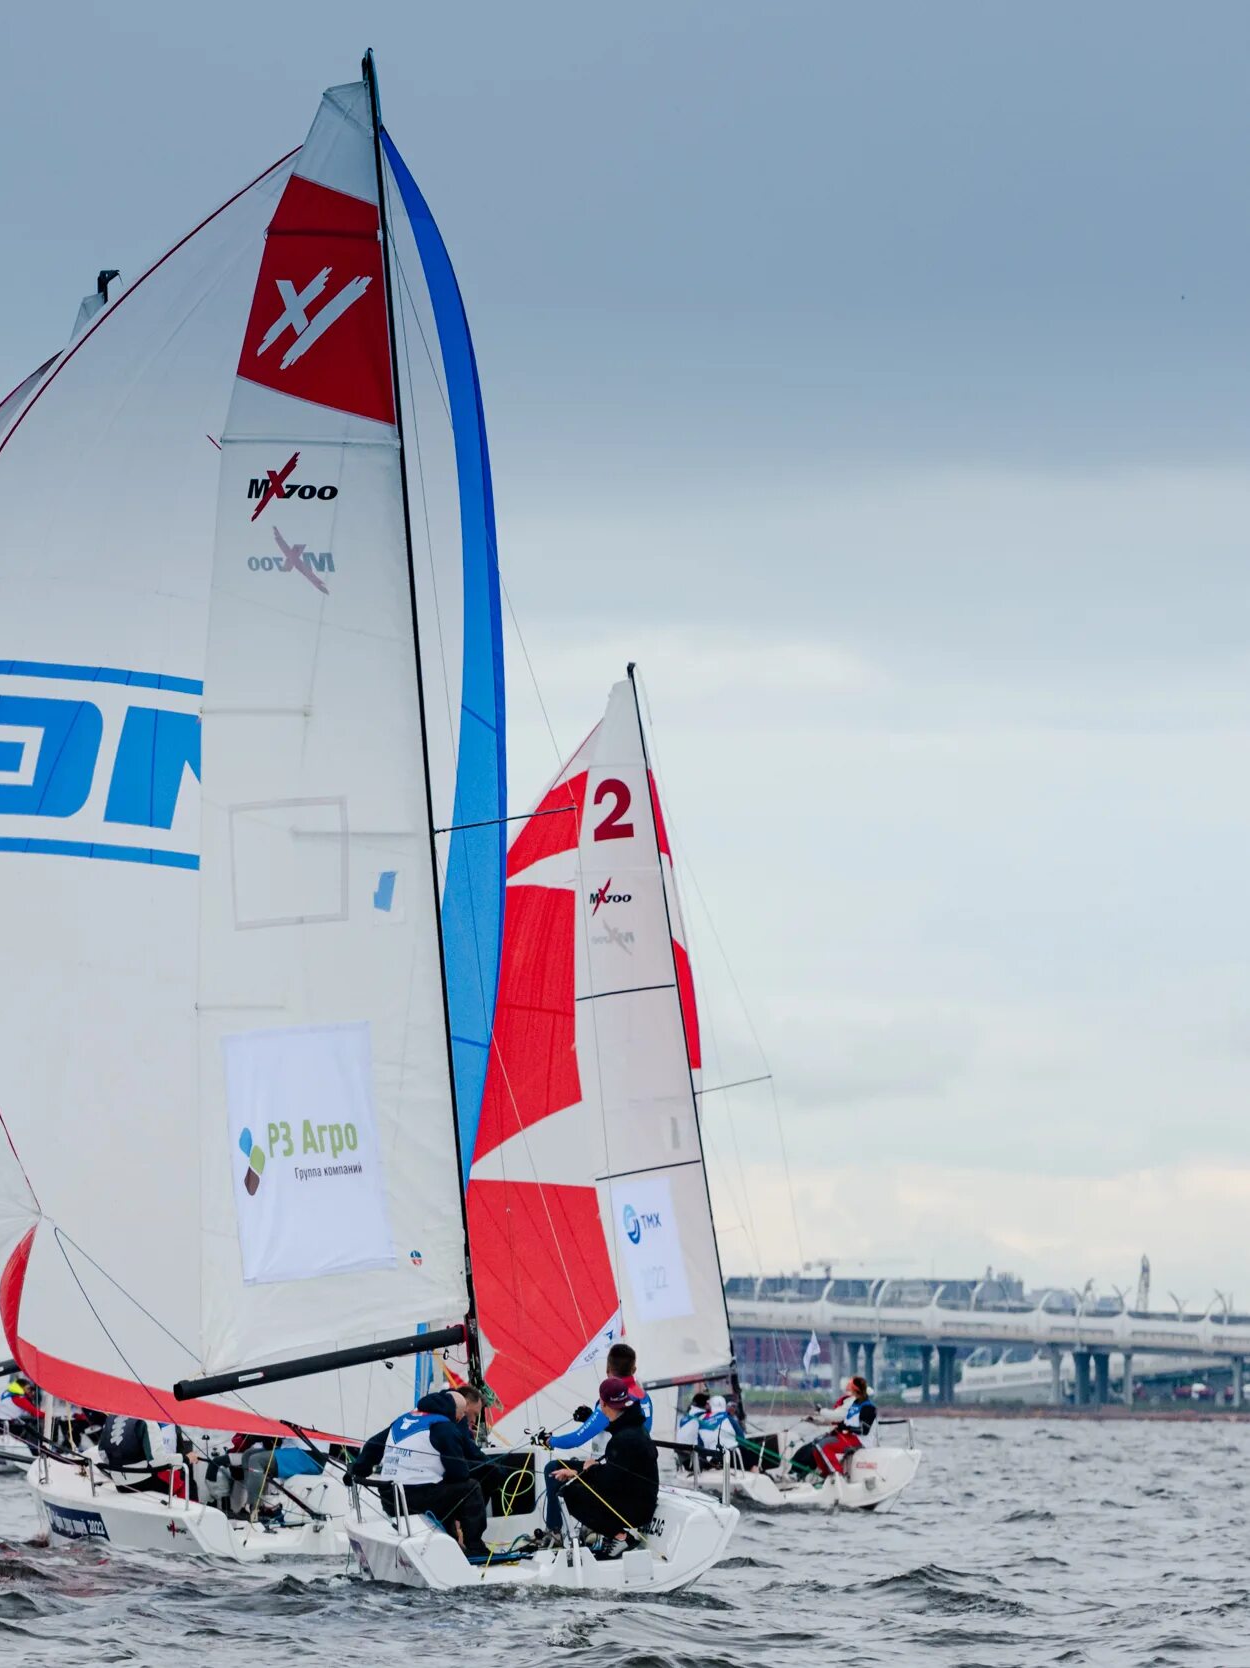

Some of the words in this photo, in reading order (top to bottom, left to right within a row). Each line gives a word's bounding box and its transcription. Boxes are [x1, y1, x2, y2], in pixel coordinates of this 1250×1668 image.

[247, 452, 339, 522] MX700
[593, 778, 635, 842] 2
[303, 1119, 358, 1159] Агро
[294, 1167, 322, 1181] Группа
[323, 1161, 363, 1177] компаний
